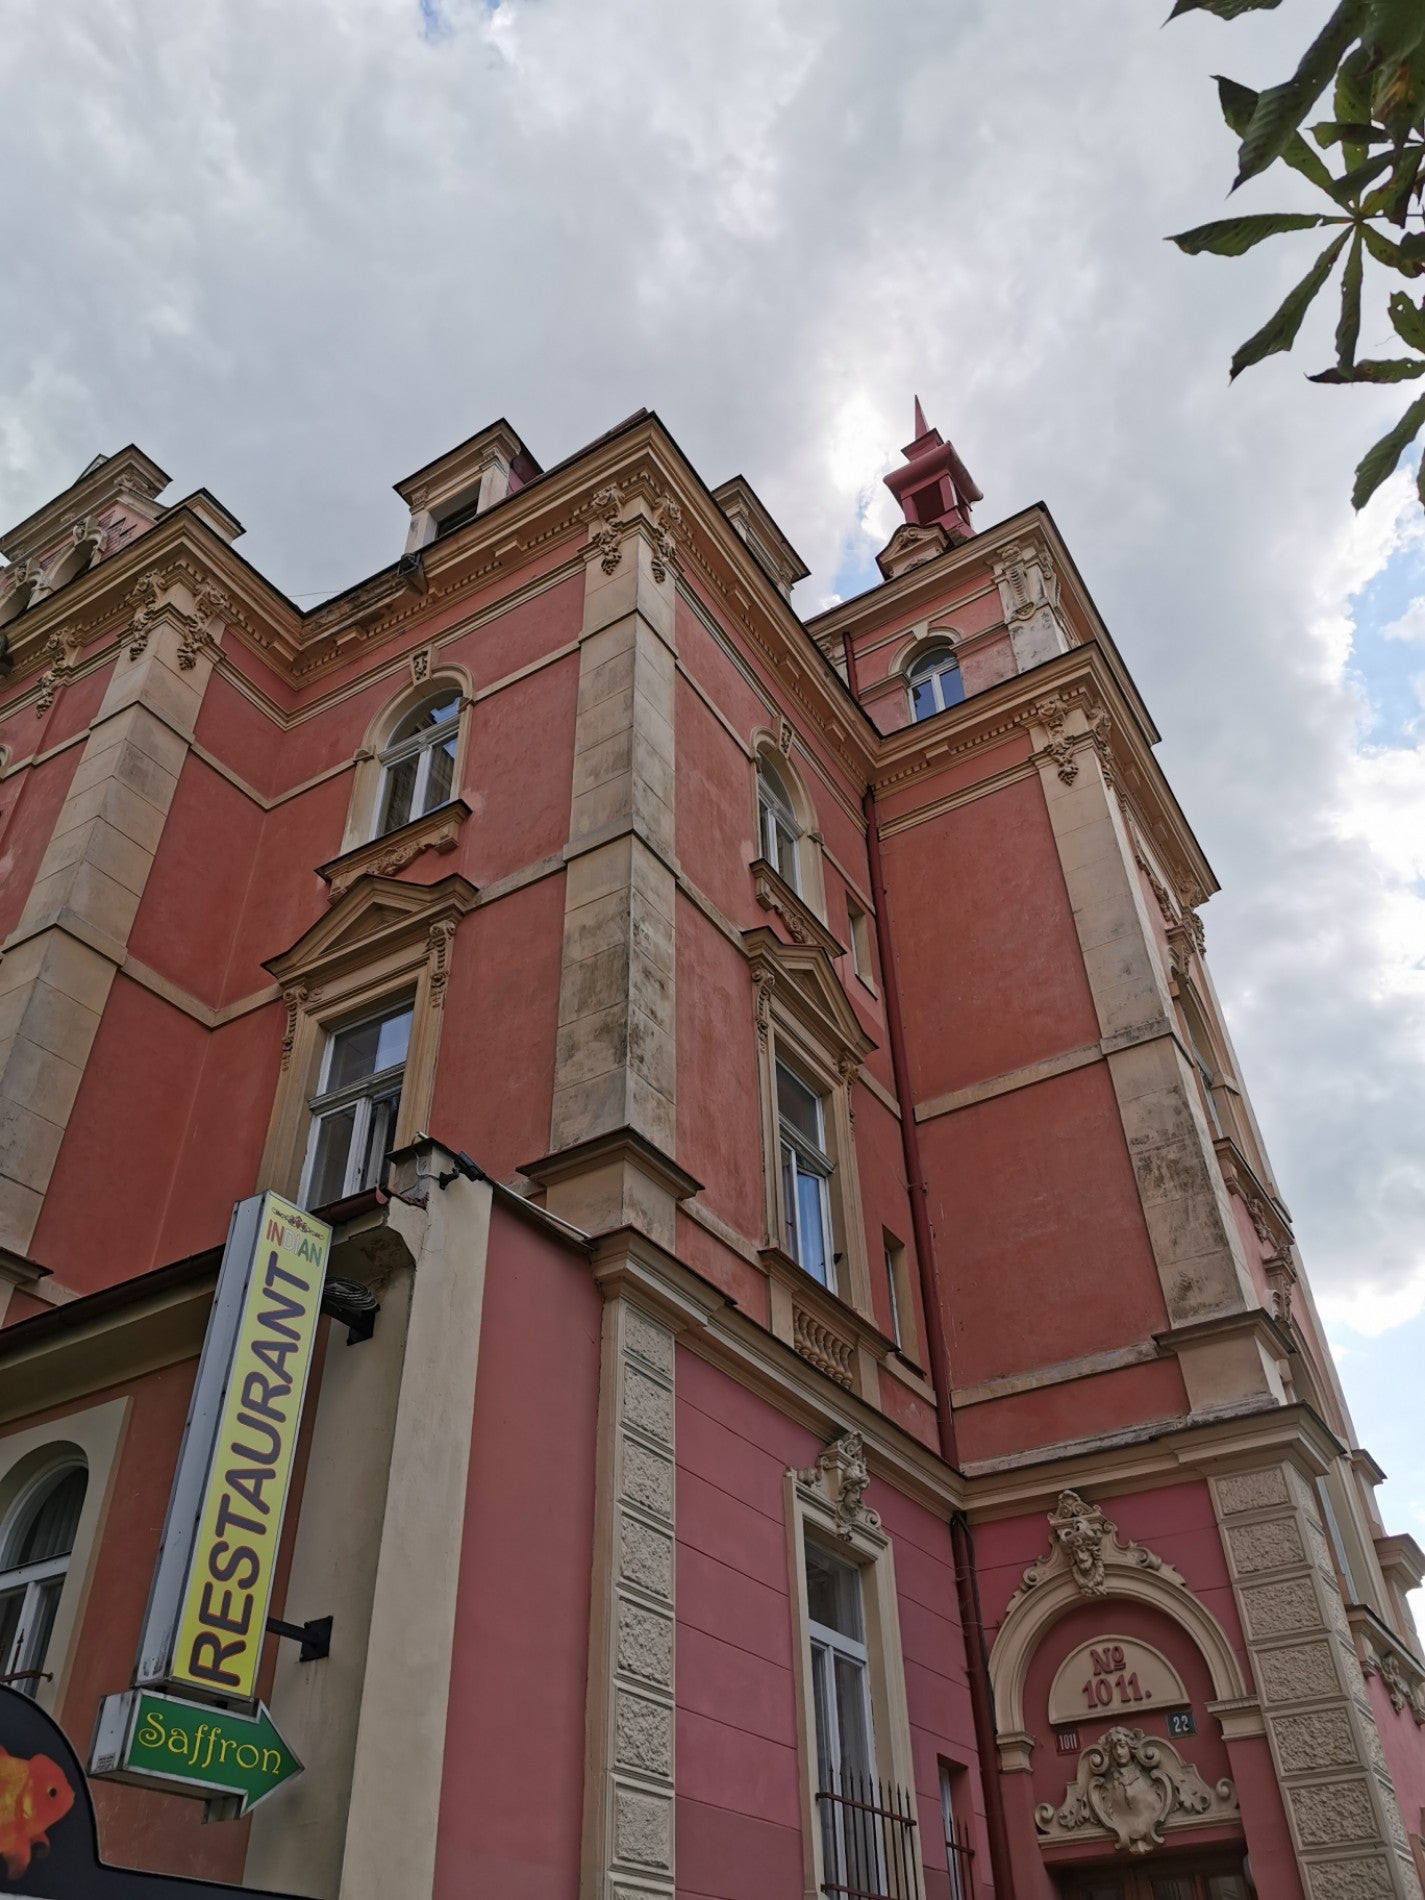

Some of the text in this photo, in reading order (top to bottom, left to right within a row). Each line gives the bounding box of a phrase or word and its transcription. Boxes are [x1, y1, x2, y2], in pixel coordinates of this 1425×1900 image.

[266, 1219, 323, 1268] INDIAN
[188, 1250, 311, 1689] RESTAURANT
[138, 1712, 281, 1775] Saffron
[1059, 1733, 1077, 1750] 1011
[1173, 1715, 1190, 1733] 22
